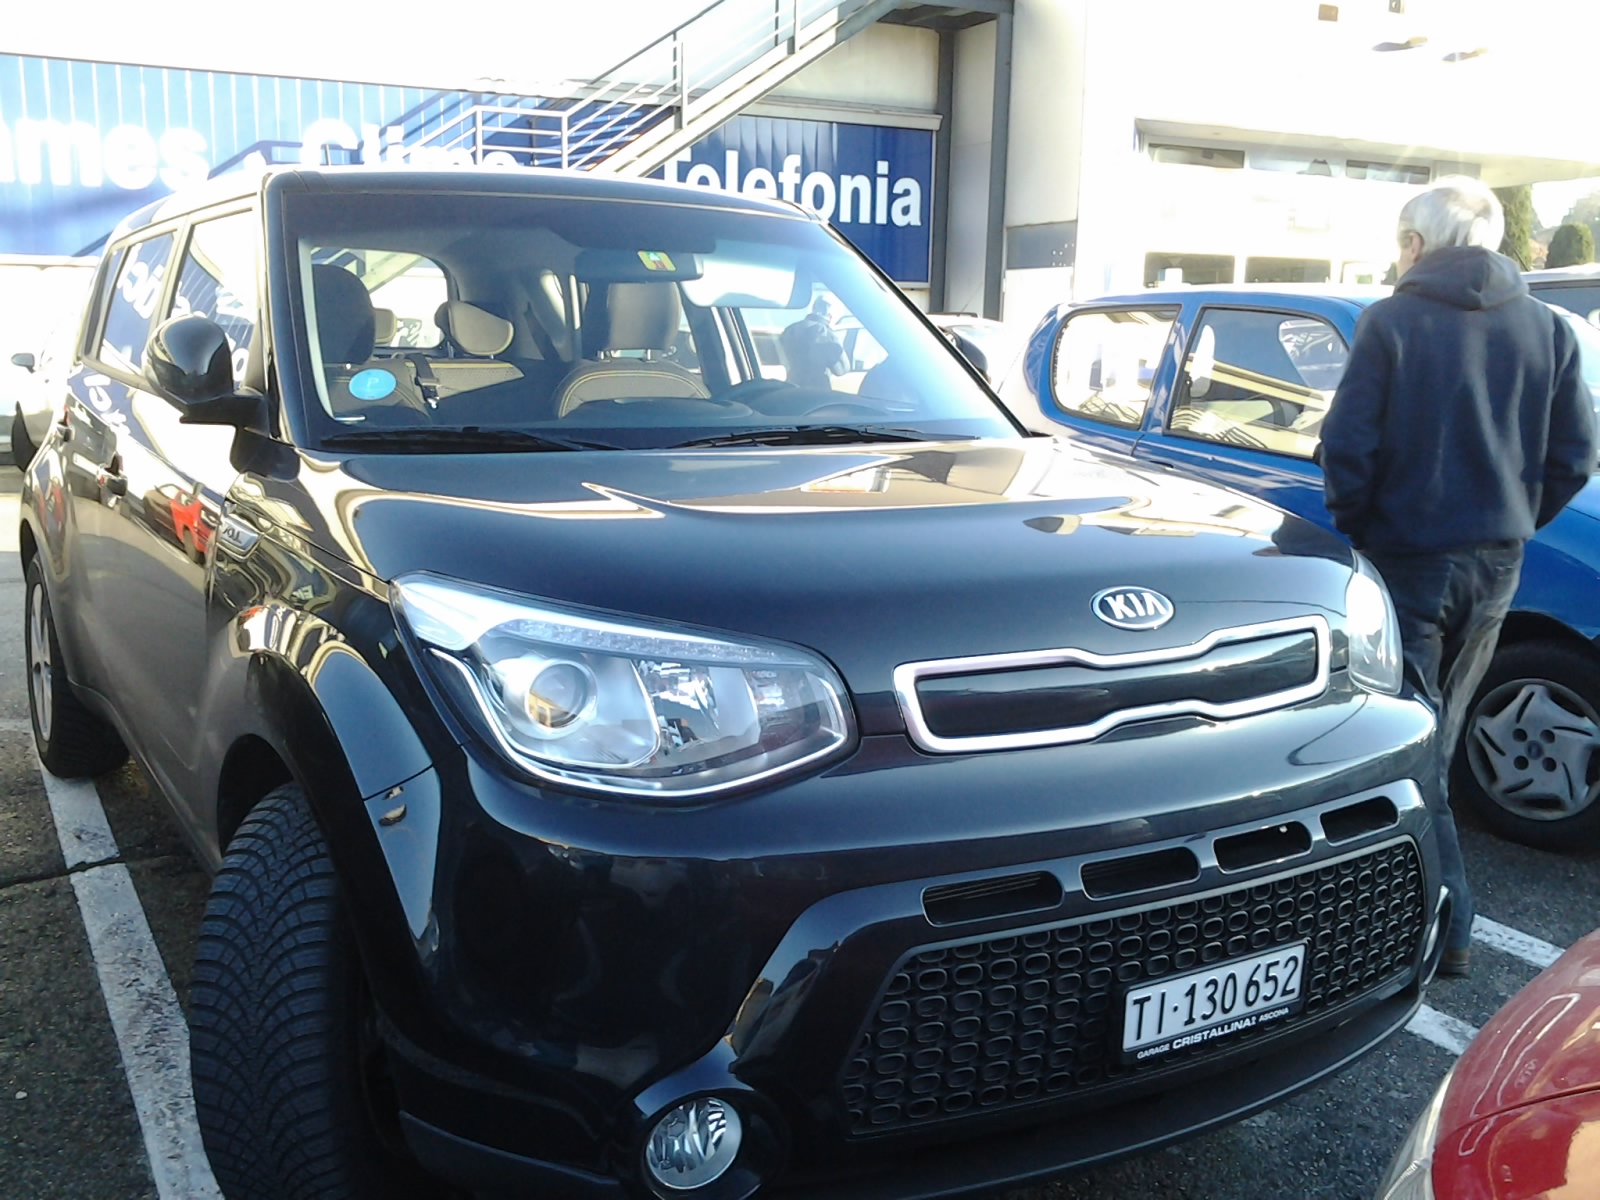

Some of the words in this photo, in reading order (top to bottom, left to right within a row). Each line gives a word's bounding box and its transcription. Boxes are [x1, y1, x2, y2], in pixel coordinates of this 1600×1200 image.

[1103, 592, 1168, 620] KIA
[1136, 1043, 1171, 1060] GARAGE
[1258, 1007, 1290, 1023] ASCONA
